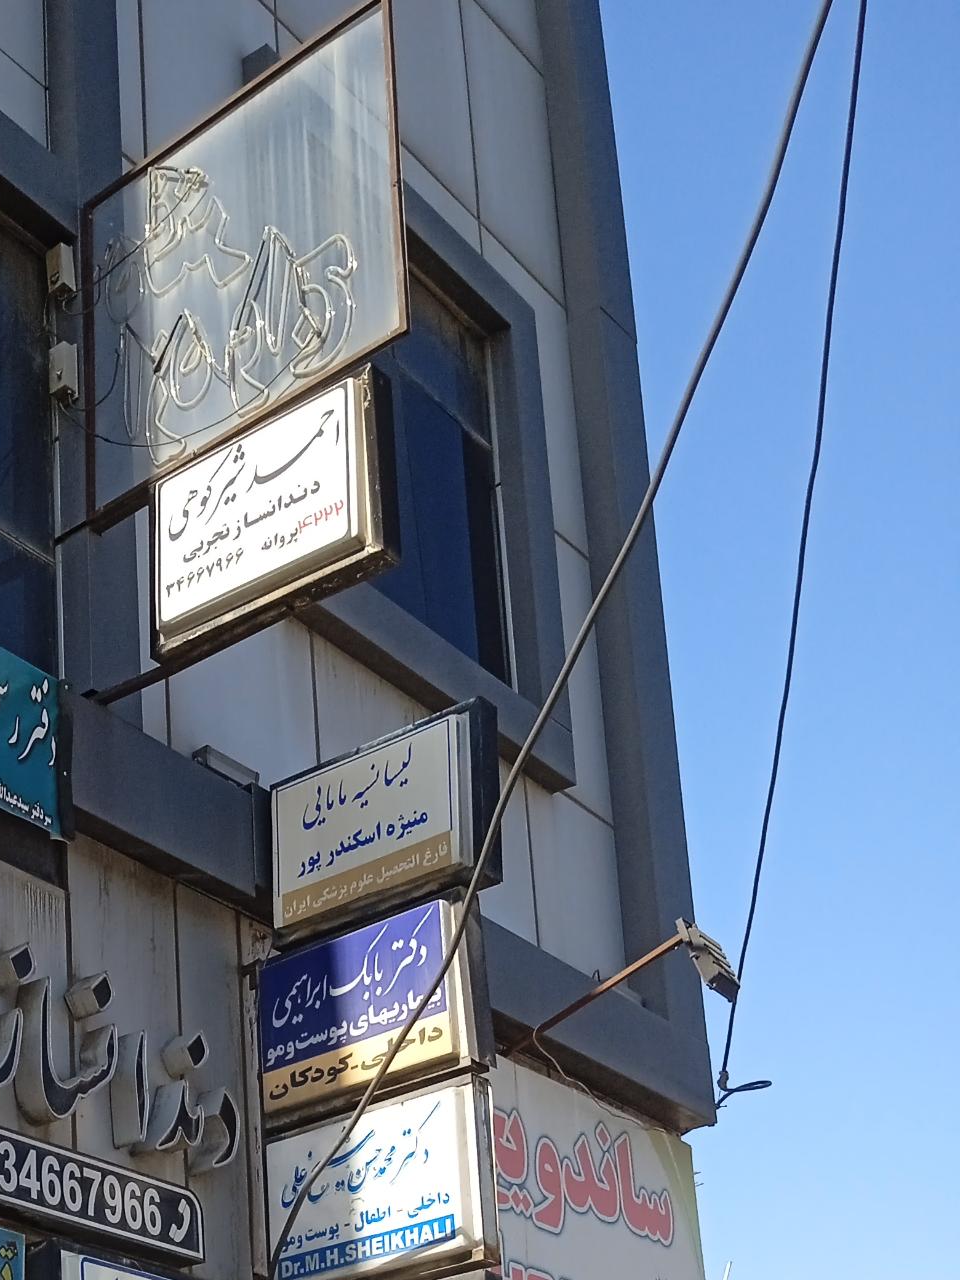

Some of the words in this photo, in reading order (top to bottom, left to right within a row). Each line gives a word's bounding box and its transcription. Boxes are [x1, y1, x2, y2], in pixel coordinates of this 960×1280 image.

[246, 409, 340, 494] احمد
[182, 523, 230, 563] تجربی
[17, 677, 56, 767] دفتر
[386, 809, 428, 841] منیژه
[284, 895, 310, 919] ایران
[330, 923, 389, 1001] بابک
[385, 906, 434, 996] دکتر
[272, 973, 327, 1028] ابراهیمی
[296, 1021, 349, 1047] پوست
[354, 1205, 391, 1233] اطفال
[407, 1191, 451, 1218] داخلی
[305, 1222, 340, 1242] پوست
